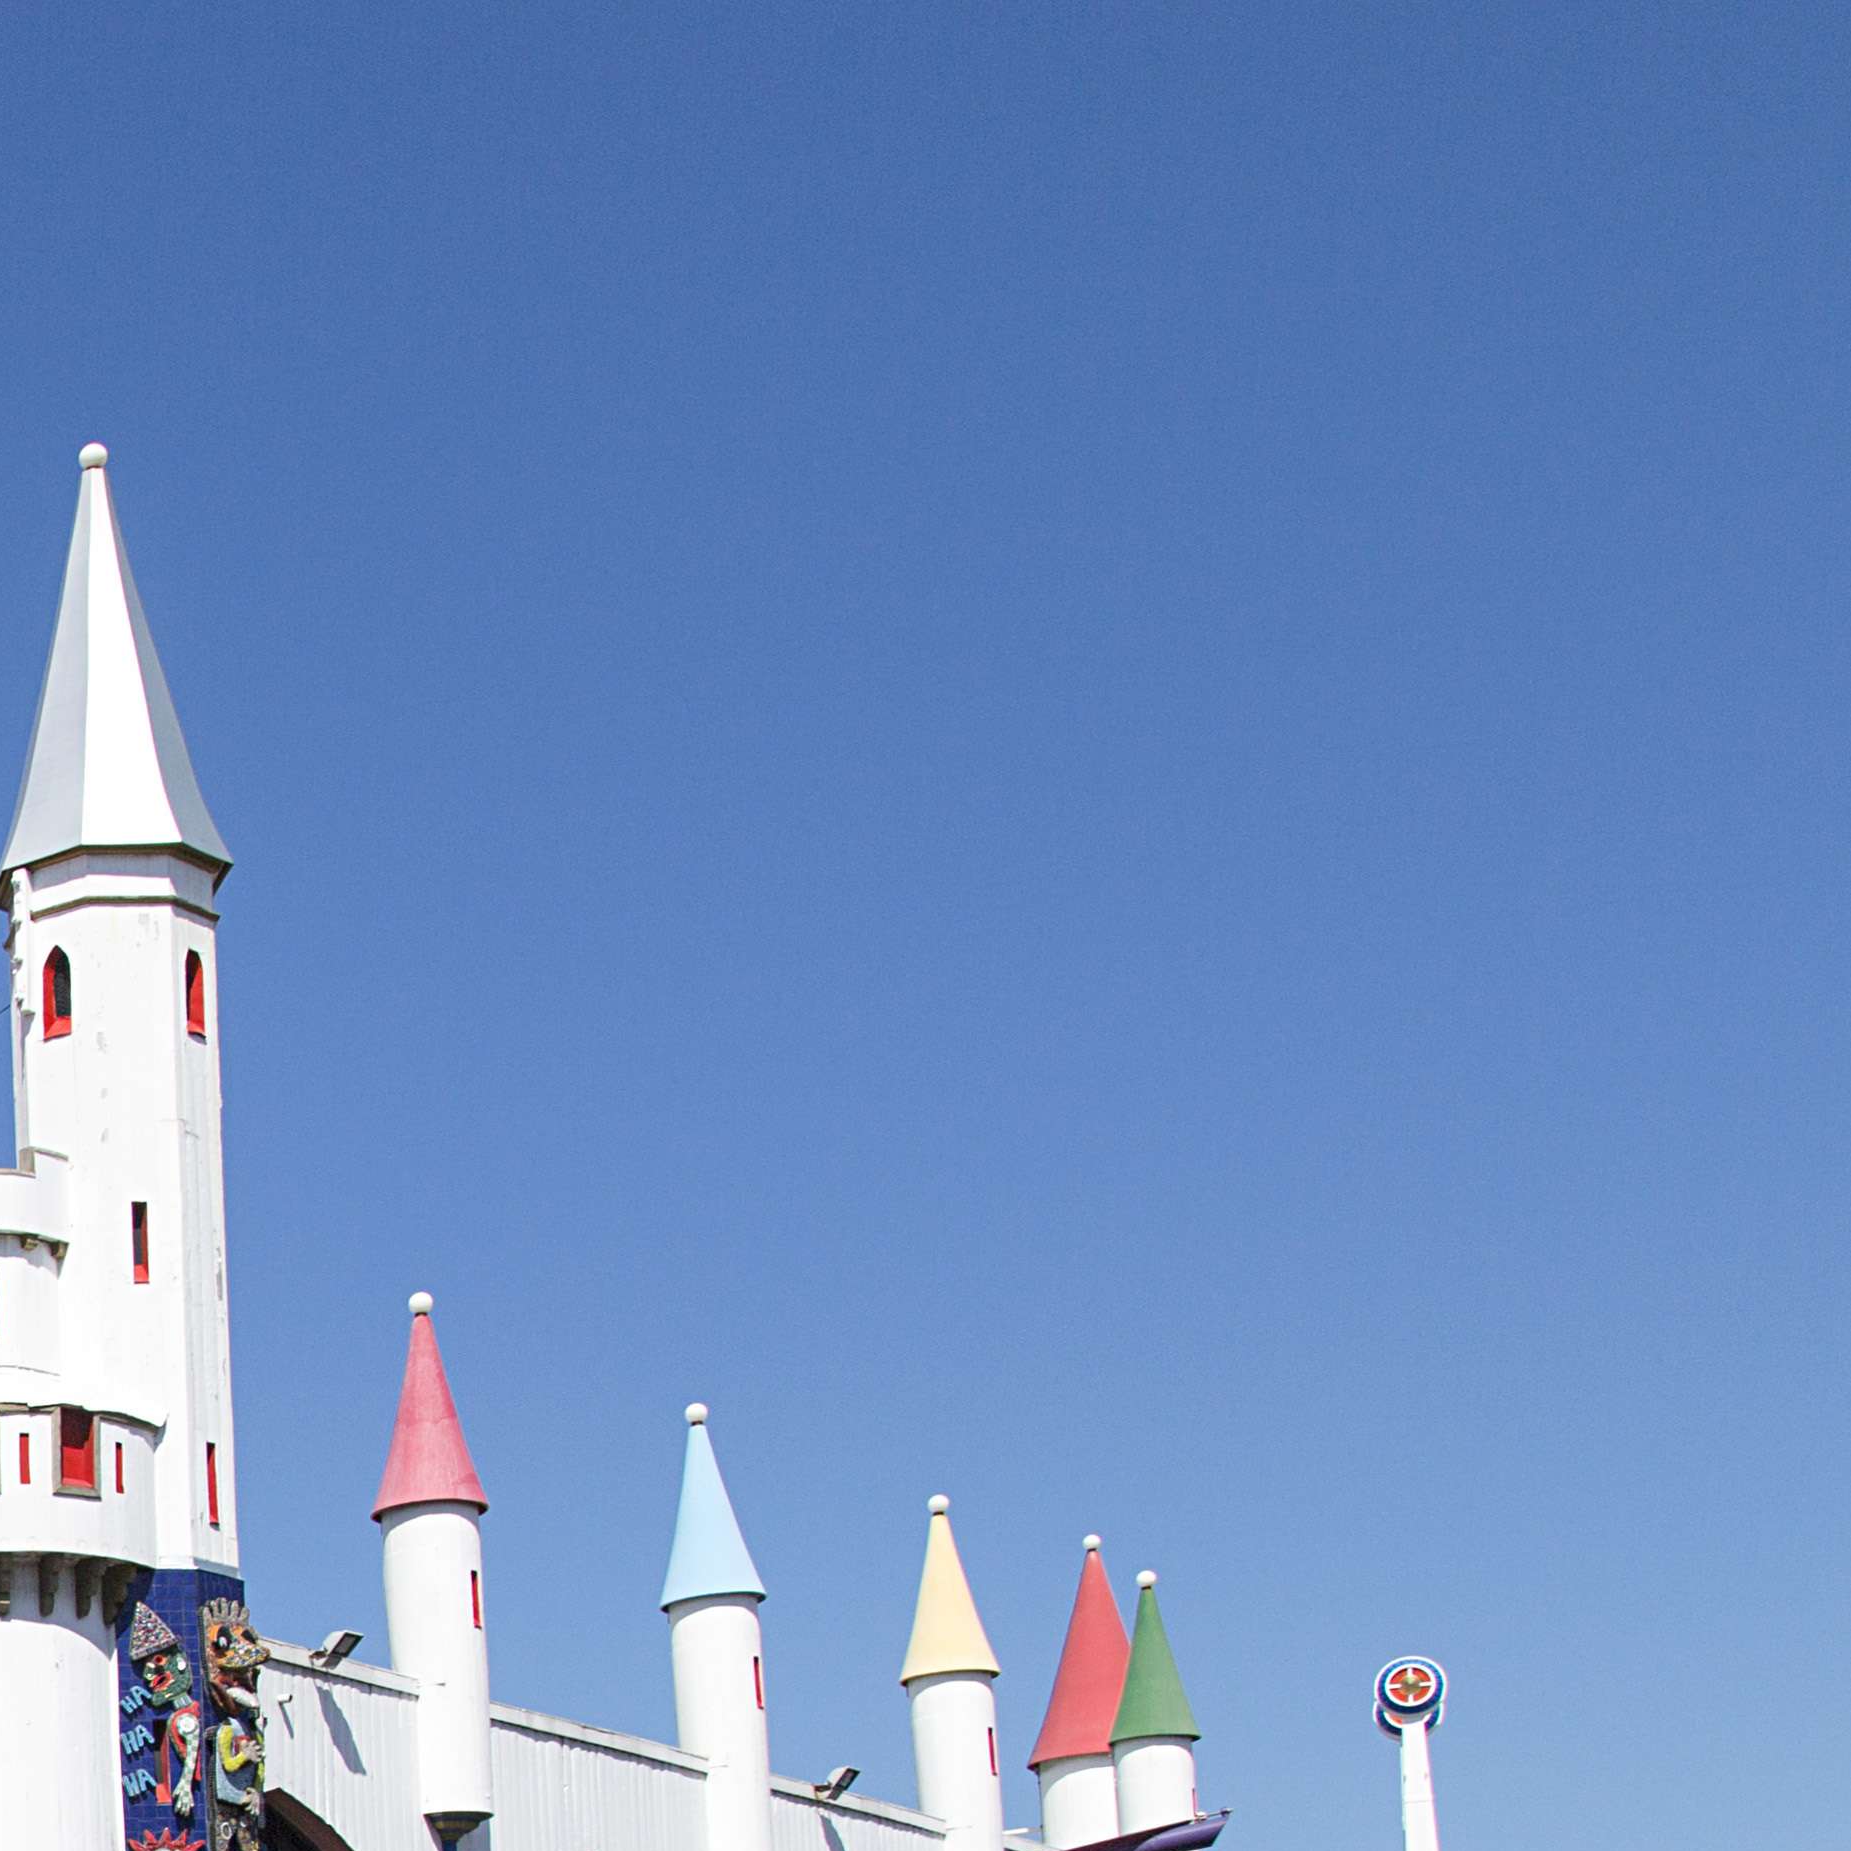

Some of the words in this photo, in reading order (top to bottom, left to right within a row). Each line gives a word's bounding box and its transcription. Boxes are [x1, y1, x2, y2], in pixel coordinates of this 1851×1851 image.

[121, 1685, 152, 1713] HA
[121, 1724, 155, 1755] HA
[123, 1769, 157, 1798] HA
